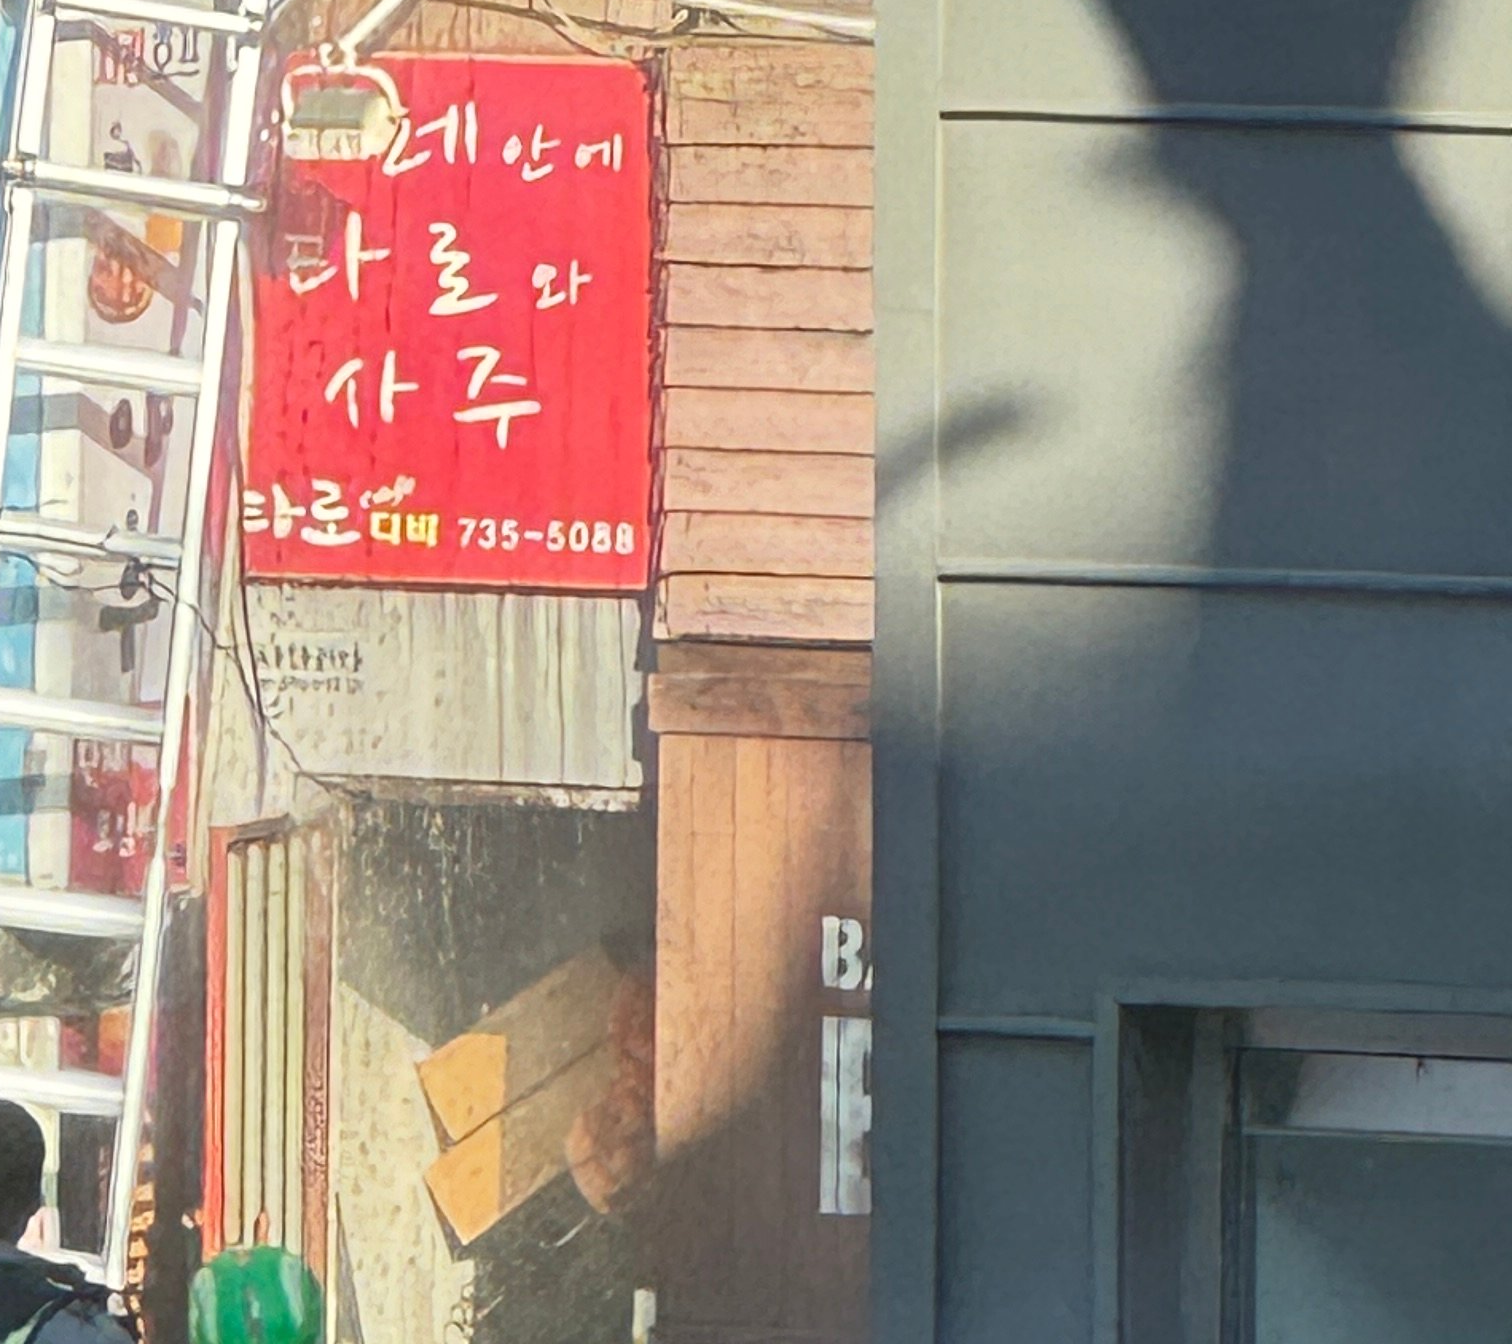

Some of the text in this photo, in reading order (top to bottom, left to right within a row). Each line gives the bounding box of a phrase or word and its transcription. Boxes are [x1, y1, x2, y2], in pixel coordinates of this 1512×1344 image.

[500, 123, 624, 182] 안에
[323, 350, 543, 450] 사주
[821, 915, 873, 991] B
